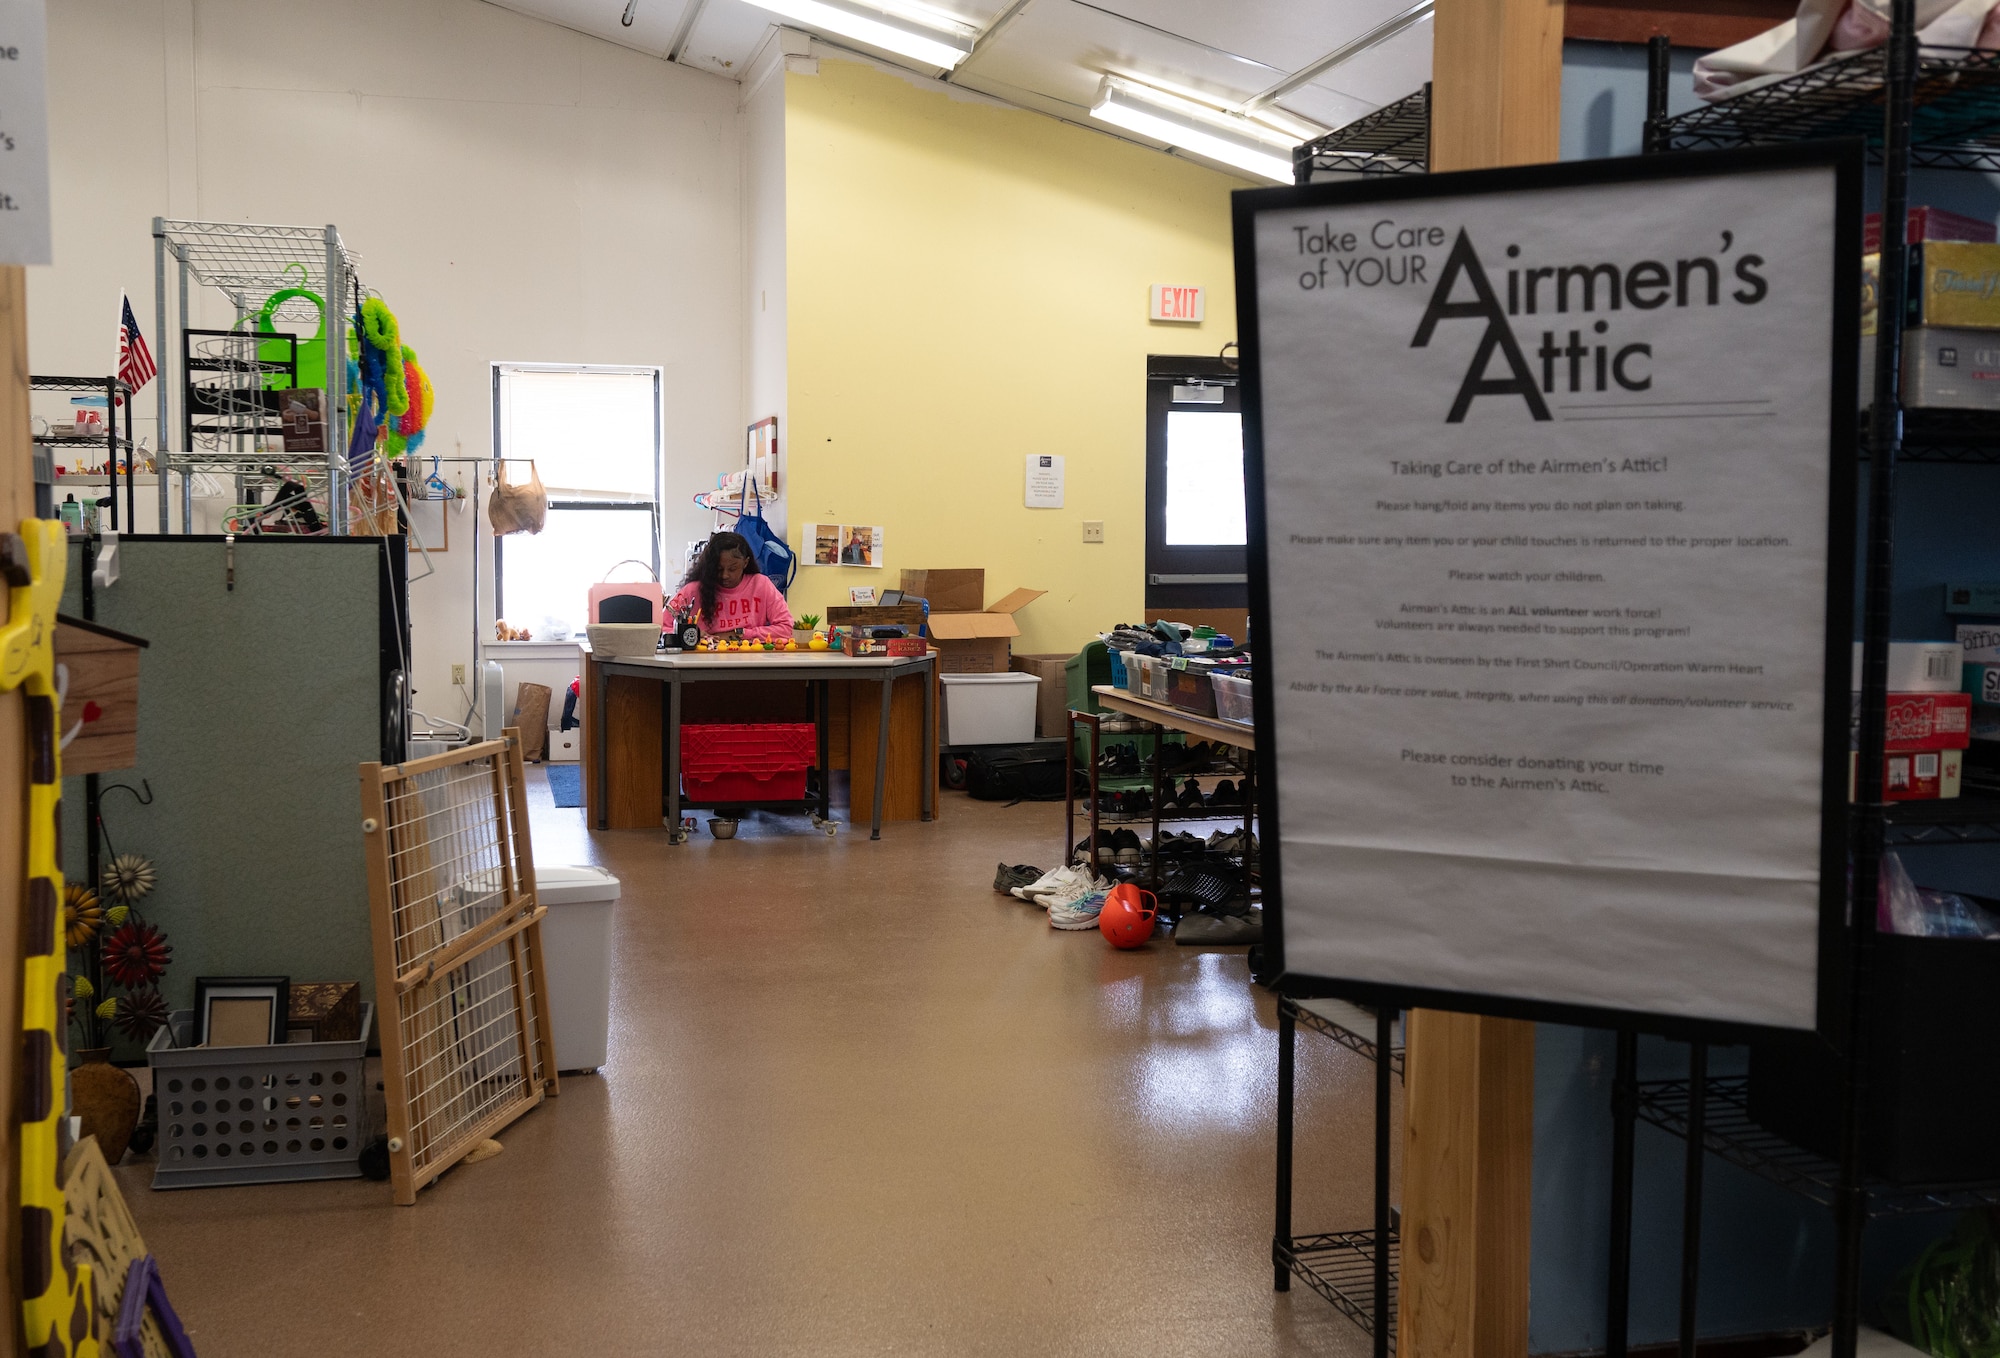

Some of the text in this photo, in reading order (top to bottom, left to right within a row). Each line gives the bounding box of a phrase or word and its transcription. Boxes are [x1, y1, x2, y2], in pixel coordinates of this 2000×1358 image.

[1293, 219, 1444, 254] Take Care
[1299, 255, 1427, 290] of YOUR
[1410, 226, 1768, 348] Airmen's
[1161, 287, 1198, 318] EXIT
[1445, 314, 1652, 423] Attic
[1391, 457, 1668, 477] Taking Care of the Airmen's Attic!
[1377, 501, 1687, 513] Please hang/fold any items you do not plan on taking.
[1290, 534, 1792, 548] Please make sure any item you or your child touches is returned to the proper location.
[1448, 570, 1606, 583] Please watch your children.
[715, 597, 761, 617] PORT
[1451, 604, 1477, 615] Attic
[1479, 605, 1488, 615] is
[1491, 607, 1504, 615] an
[1508, 605, 1528, 616] ALL
[1531, 606, 1589, 617] volunteer
[1592, 607, 1622, 618] work
[1625, 608, 1661, 619] force!
[719, 616, 749, 629] DEPT
[1376, 619, 1691, 638] Volunteers are always needed to support this program!
[1315, 650, 1763, 675] The Airmen's Attic is overseen by the First Shirt Council/Operation Warm Heart
[1290, 682, 1318, 692] Abide
[1321, 683, 1333, 694] by
[1336, 683, 1352, 693] the
[1355, 684, 1370, 694] Air
[1373, 685, 1401, 696] Force
[1430, 688, 1462, 699] value,
[1519, 692, 1549, 702] when
[1553, 694, 1584, 706] using
[1587, 694, 1609, 705] this
[1630, 695, 1748, 709] donation/volunteer
[1750, 701, 1796, 711] service.
[1401, 749, 1665, 775] Please consider donating your time
[1451, 774, 1609, 793] to the Airmen's Attic.
